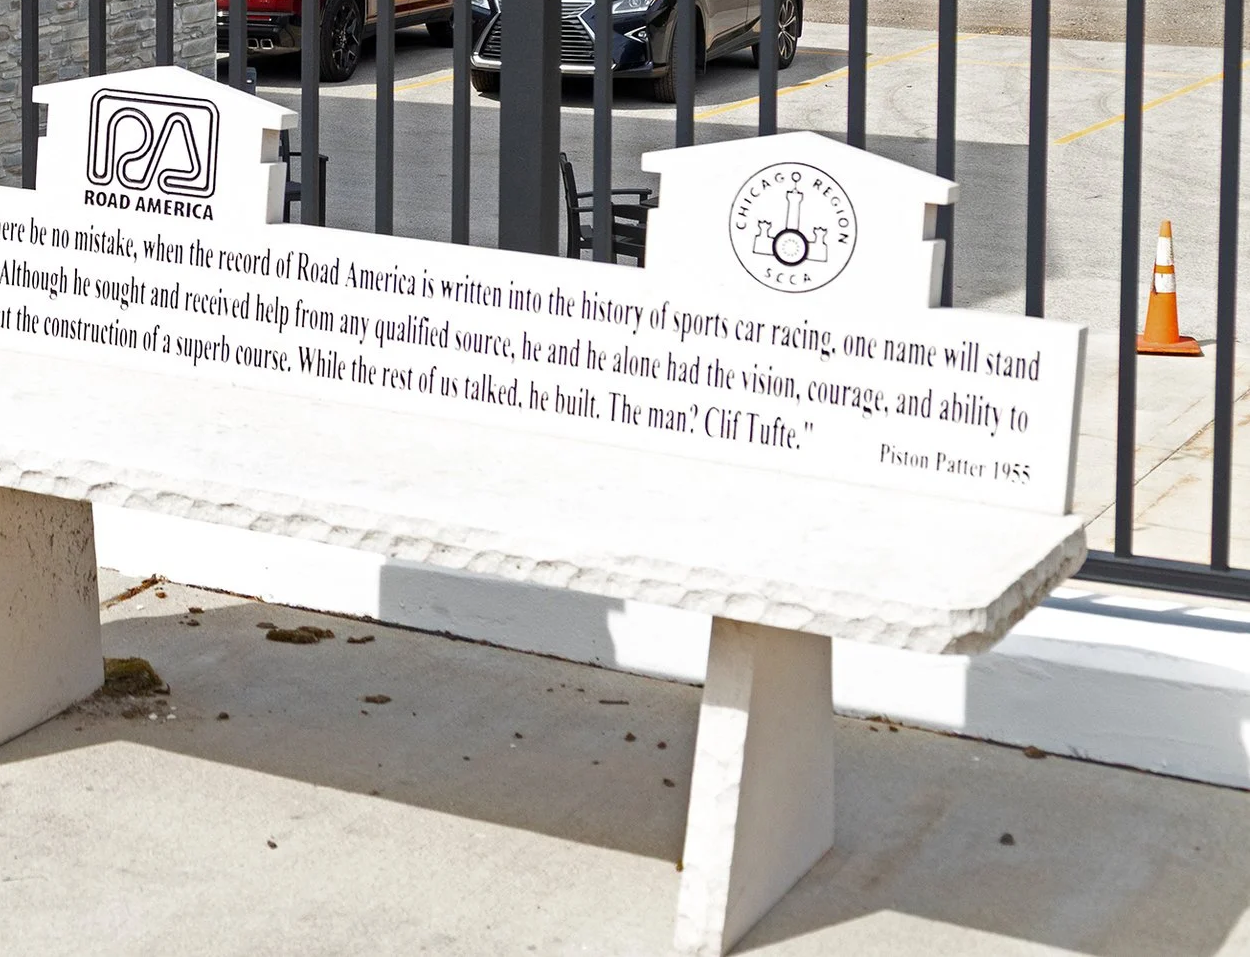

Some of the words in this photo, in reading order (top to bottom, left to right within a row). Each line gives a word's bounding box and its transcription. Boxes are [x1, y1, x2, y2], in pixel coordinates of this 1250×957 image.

[84, 190, 130, 210] ROAD
[135, 196, 214, 221] AMERICA
[736, 171, 801, 230] CHICAGO
[813, 178, 849, 244] REGION
[30, 217, 46, 245] be
[52, 228, 69, 248] no
[75, 225, 137, 261] mistake,
[144, 234, 183, 264] when
[190, 239, 213, 268] the
[219, 248, 270, 275] record
[276, 251, 294, 278] of
[298, 253, 339, 285] Road
[346, 262, 415, 295] America
[423, 269, 433, 297] is
[441, 275, 501, 307] written
[509, 281, 541, 312] into
[549, 287, 574, 317] the
[582, 291, 643, 334] history
[650, 301, 669, 329] of
[674, 313, 727, 342] sports
[736, 320, 765, 342] car
[844, 334, 878, 358] one
[884, 340, 937, 367] name
[945, 341, 978, 372] will
[987, 351, 1040, 380] stand
[765, 267, 811, 285] SCCA
[0, 260, 67, 299] Although
[74, 268, 90, 296] he
[96, 276, 145, 310] sought
[151, 282, 179, 309] and
[185, 288, 249, 319] received
[256, 294, 288, 333] help
[296, 299, 333, 331] from
[340, 314, 369, 344] any
[375, 315, 449, 348] qualified
[456, 330, 514, 364] source,
[523, 332, 541, 362] he
[548, 339, 579, 366] and
[587, 340, 606, 371] he
[613, 346, 660, 378] alone
[667, 352, 699, 384] had
[708, 359, 734, 389] the
[742, 364, 799, 405] vision,
[808, 382, 888, 419] courage,
[896, 389, 932, 418] and
[940, 392, 998, 436] ability
[1010, 408, 1027, 431] to
[17, 306, 39, 334] the
[44, 317, 137, 348] construction
[143, 325, 160, 351] of
[163, 335, 170, 353] a
[177, 335, 229, 366] superb
[236, 346, 290, 371] course.
[299, 346, 345, 380] While
[352, 355, 376, 385] the
[383, 368, 412, 390] rest
[419, 366, 437, 393] of
[441, 377, 457, 396] us
[530, 381, 548, 411] he
[556, 385, 599, 418] built.
[609, 392, 641, 425] The
[649, 404, 698, 433] man?
[705, 407, 741, 440] Clif
[881, 444, 928, 468] Piston
[937, 452, 986, 476] Patter
[994, 460, 1031, 485] 1955
